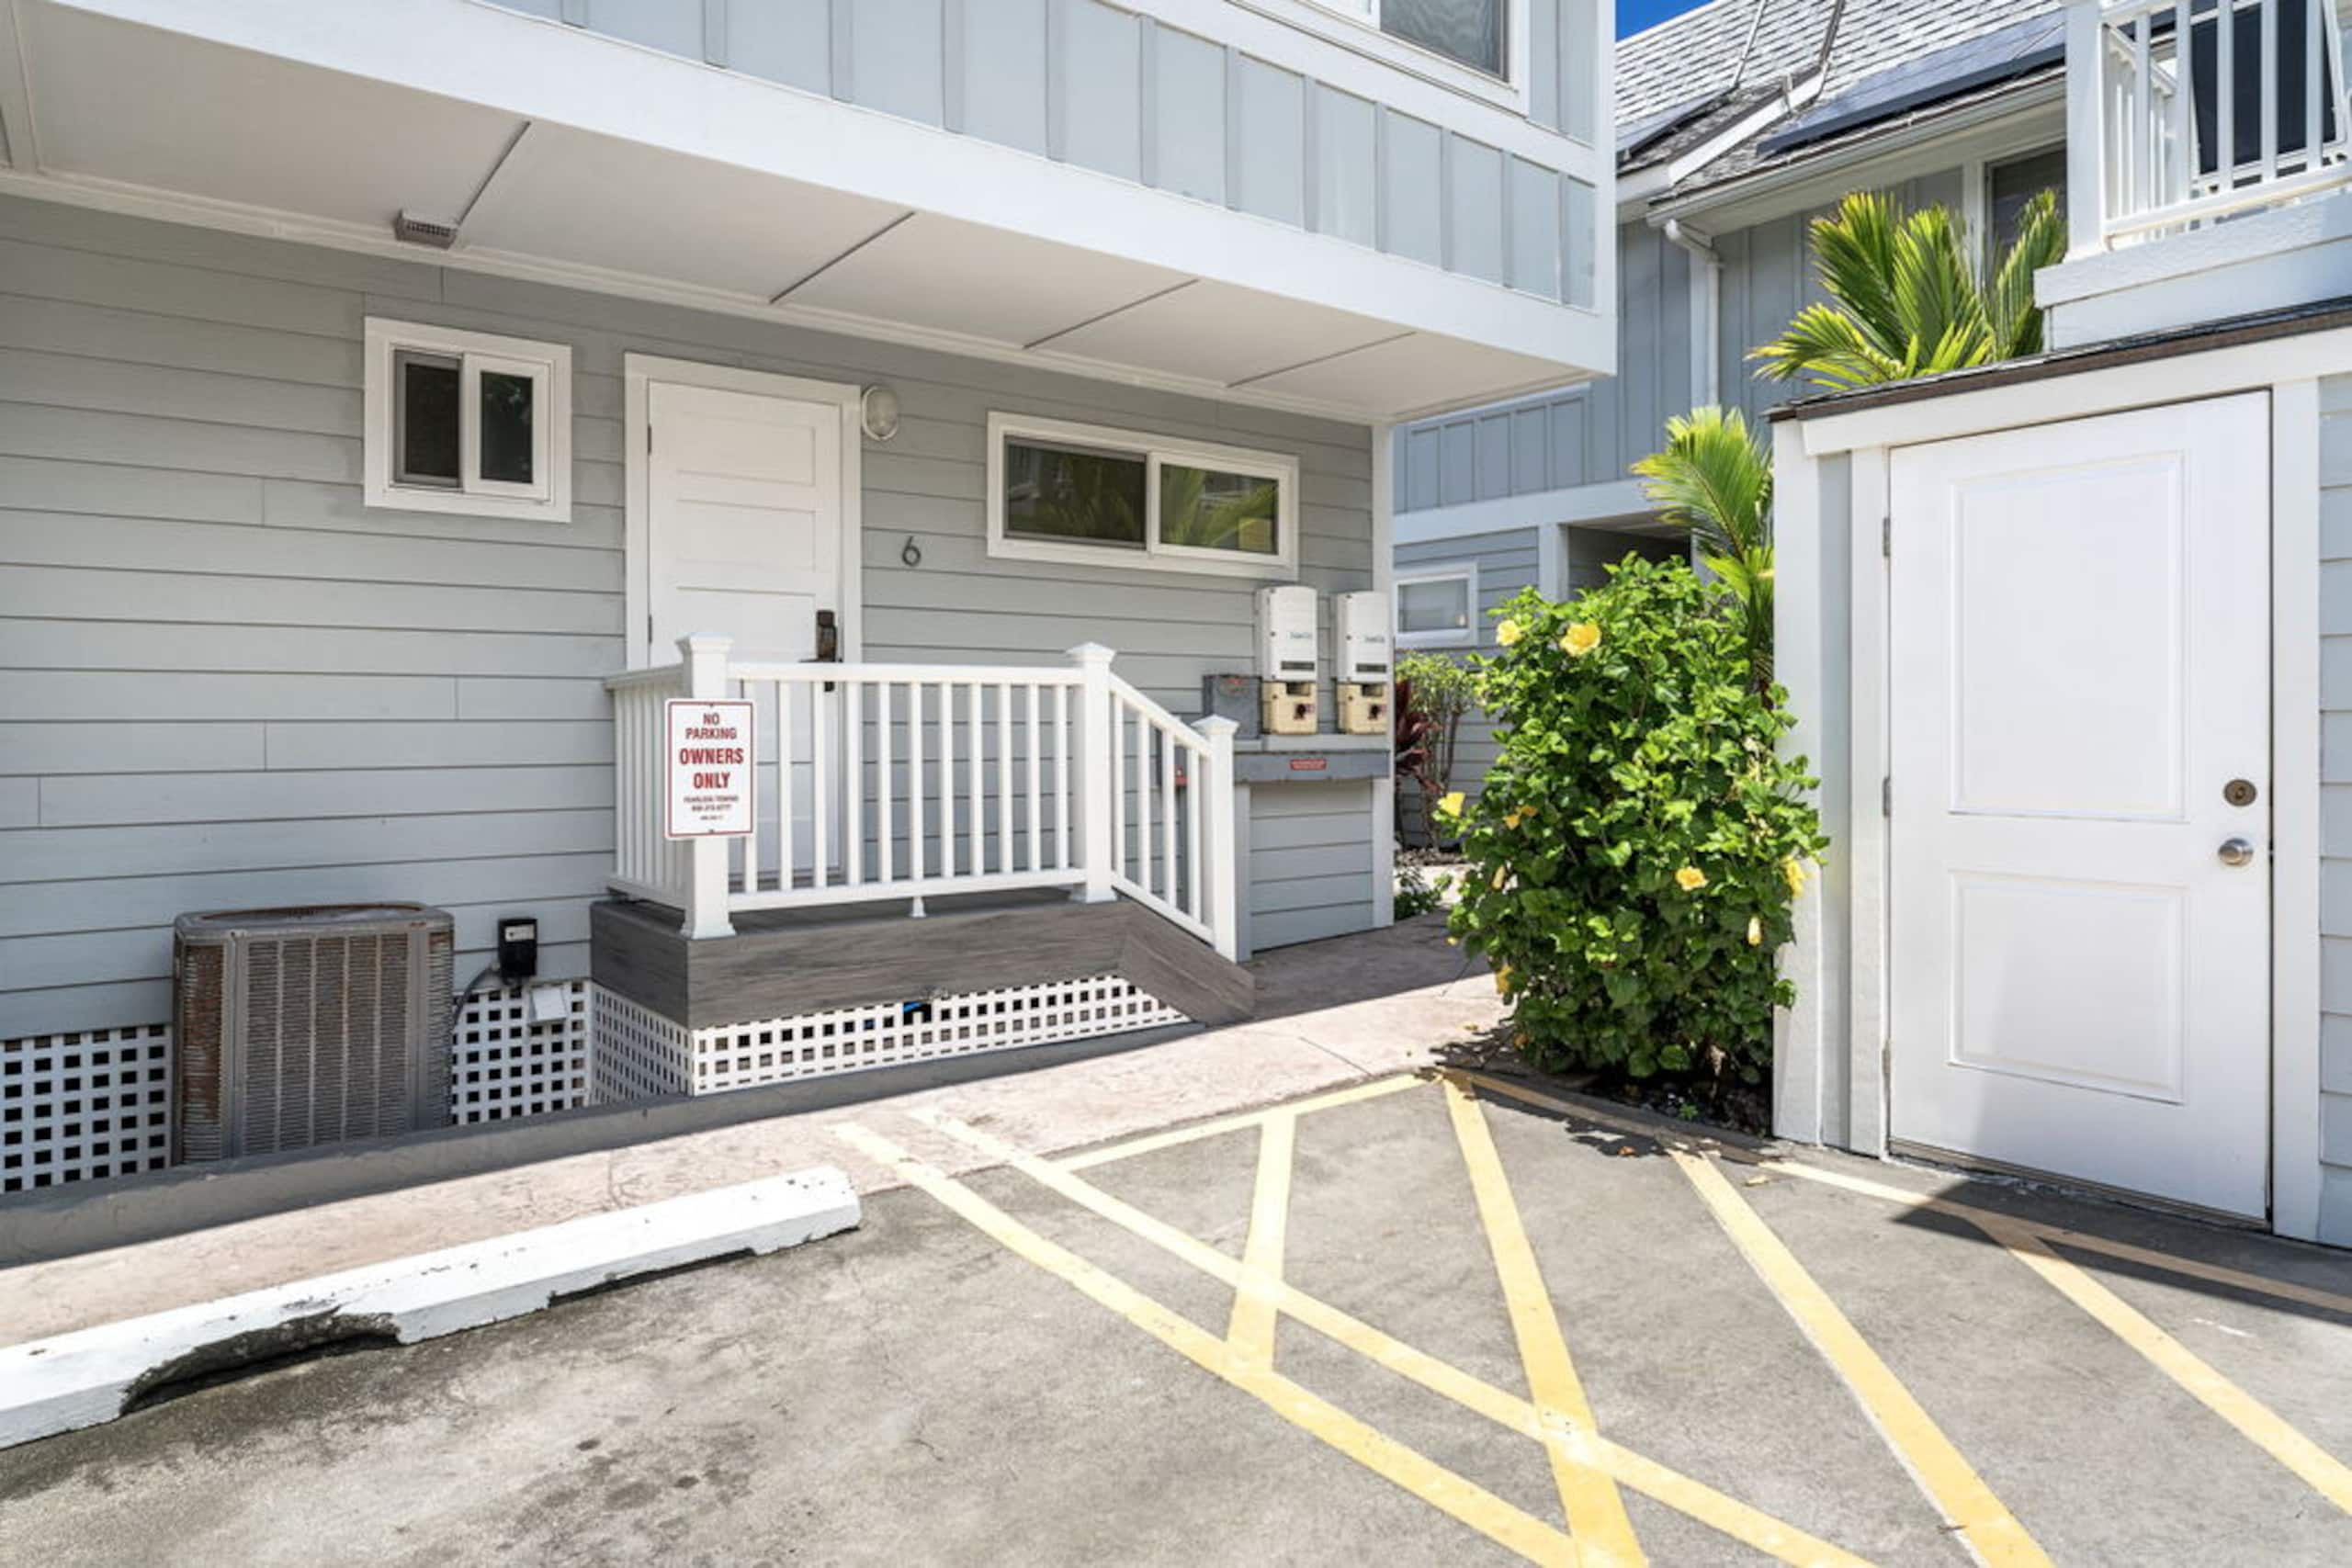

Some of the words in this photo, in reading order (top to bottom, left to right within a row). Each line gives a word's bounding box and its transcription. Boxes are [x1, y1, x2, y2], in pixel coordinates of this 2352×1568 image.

[902, 536, 921, 566] 6
[703, 712, 720, 725] NO
[685, 728, 738, 740] PARKING
[680, 748, 744, 765] OWNERS
[694, 773, 730, 789] ONLY
